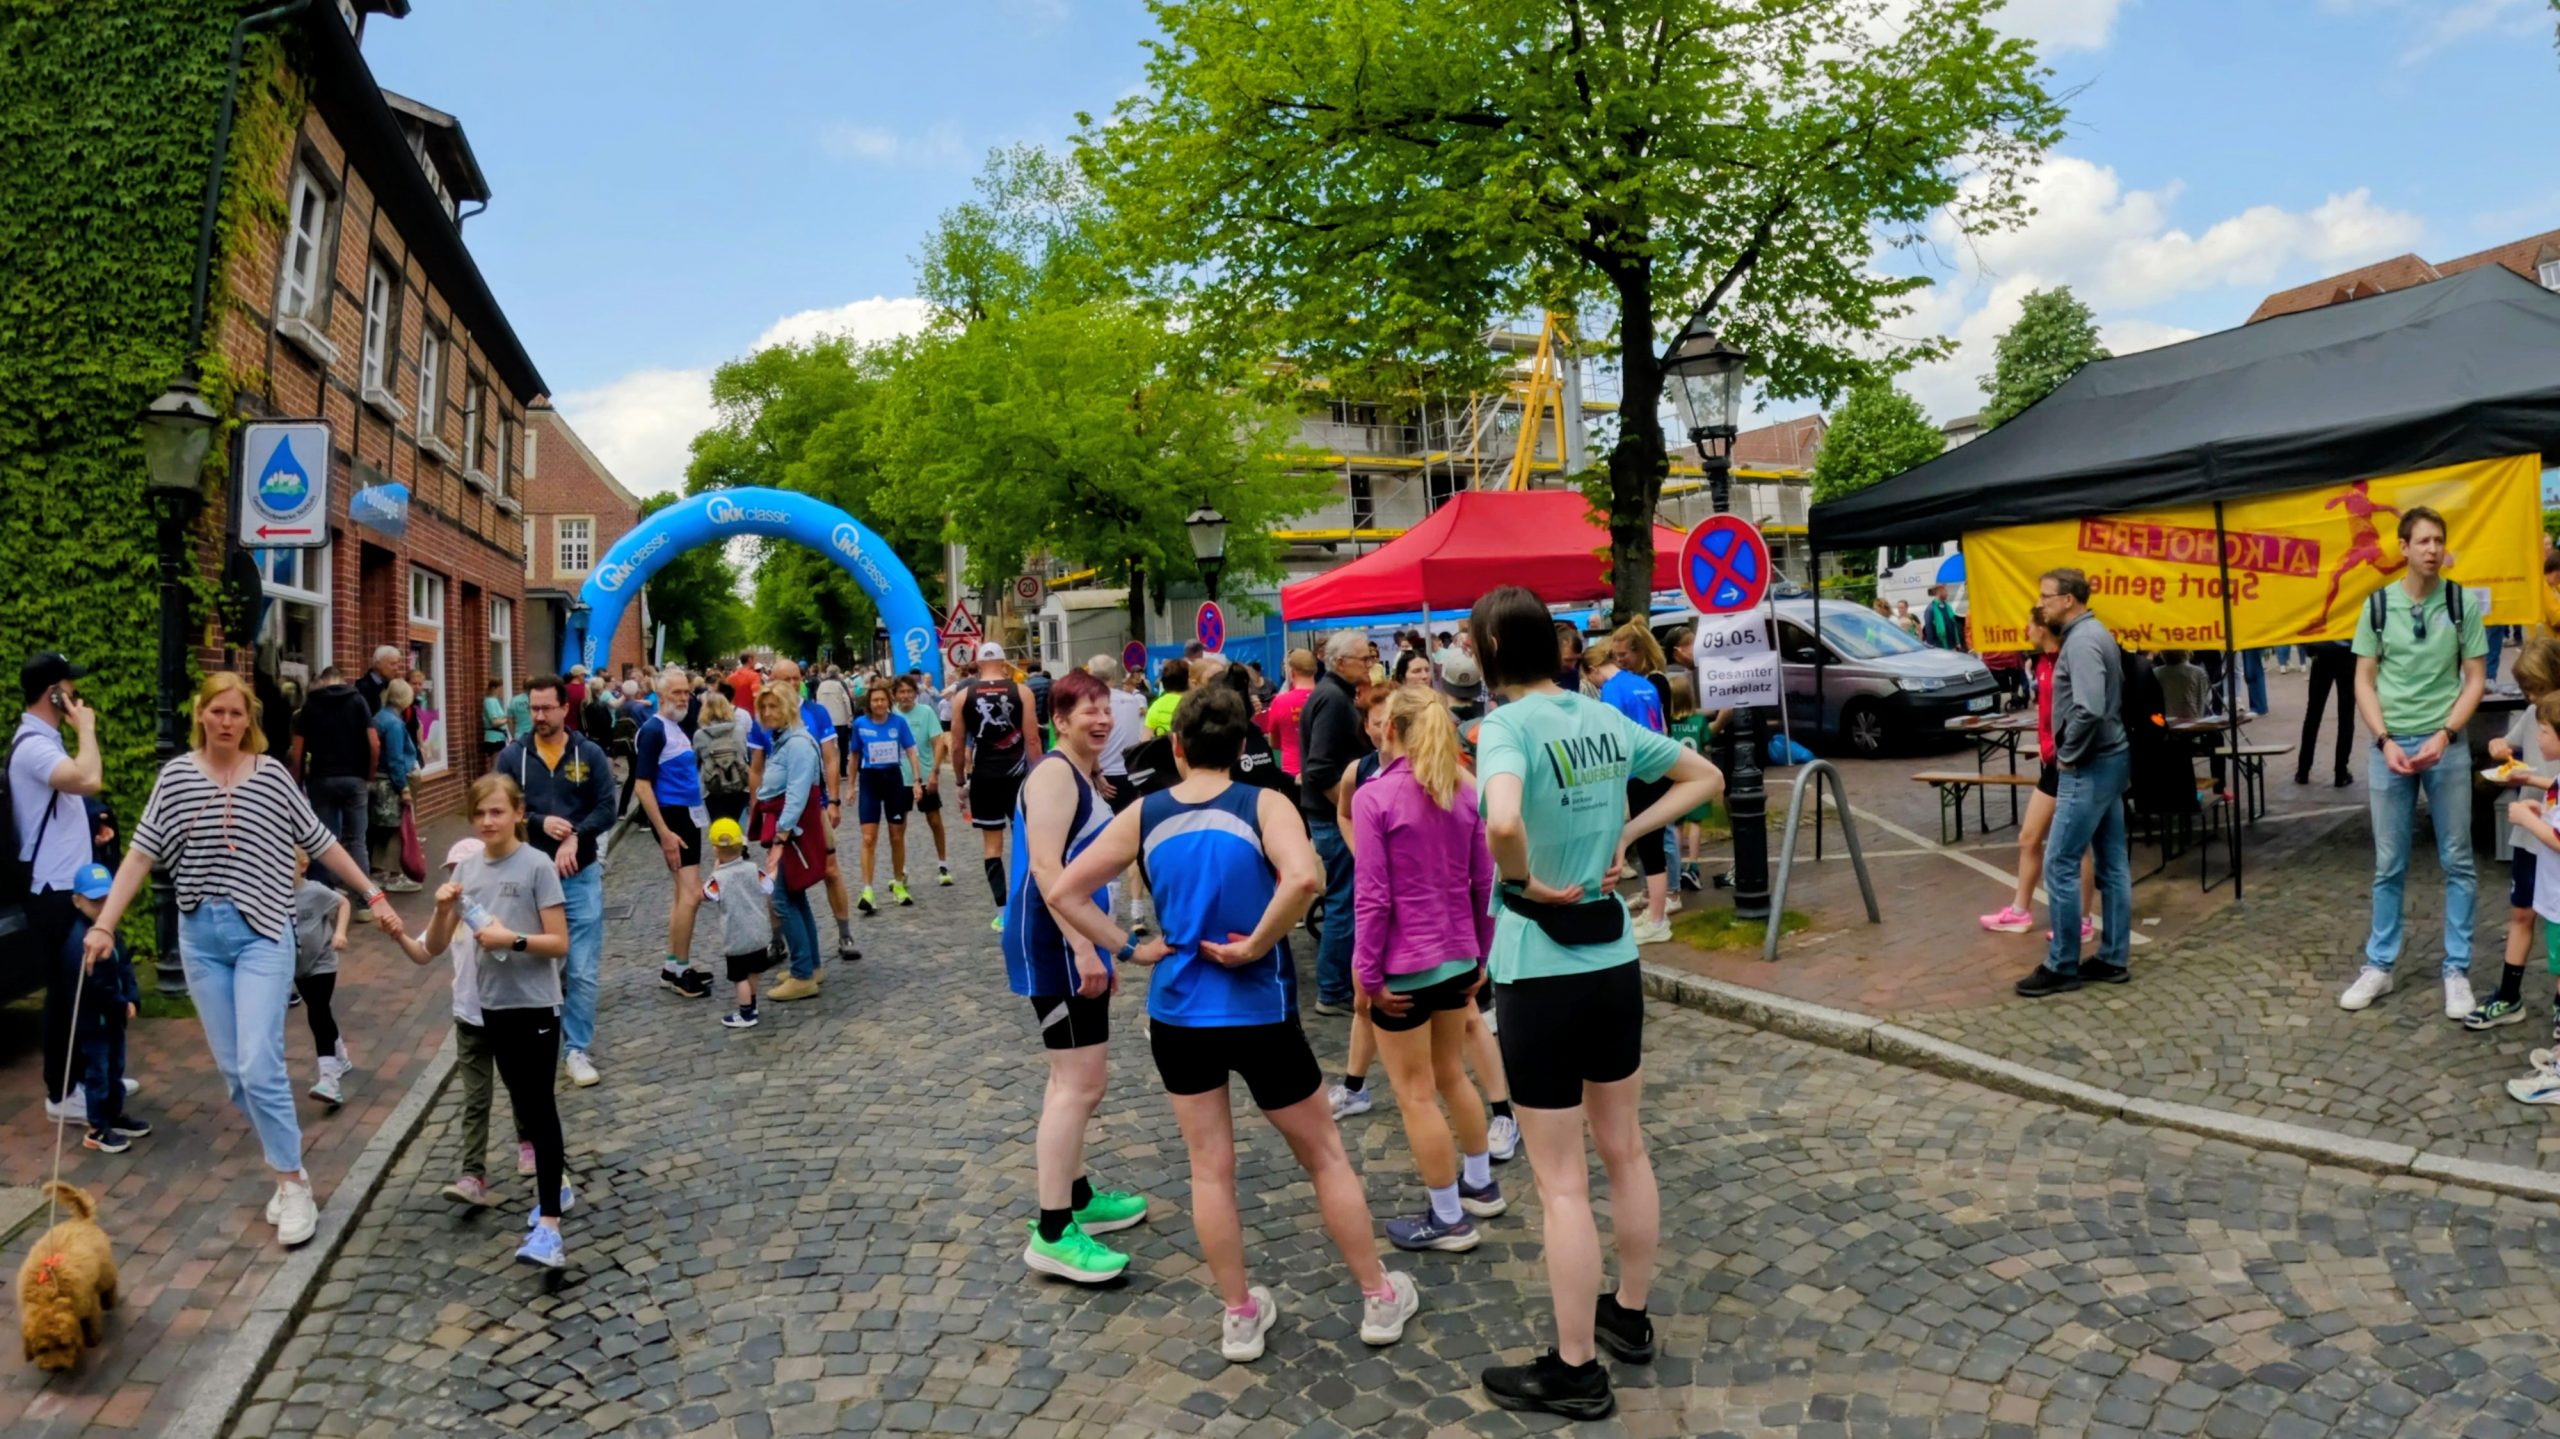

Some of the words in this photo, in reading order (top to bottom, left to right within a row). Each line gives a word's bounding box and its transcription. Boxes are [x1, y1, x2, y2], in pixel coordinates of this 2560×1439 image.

[745, 509, 791, 525] classic
[631, 532, 670, 566] classic
[858, 555, 892, 595] classic
[1022, 582, 1035, 593] 20
[1703, 629, 1762, 648] 09.05.
[1707, 668, 1773, 680] Gesamter
[1709, 683, 1772, 697] Parkplatz
[1561, 732, 1627, 769] WML
[1574, 764, 1627, 786] LAUFSERIE
